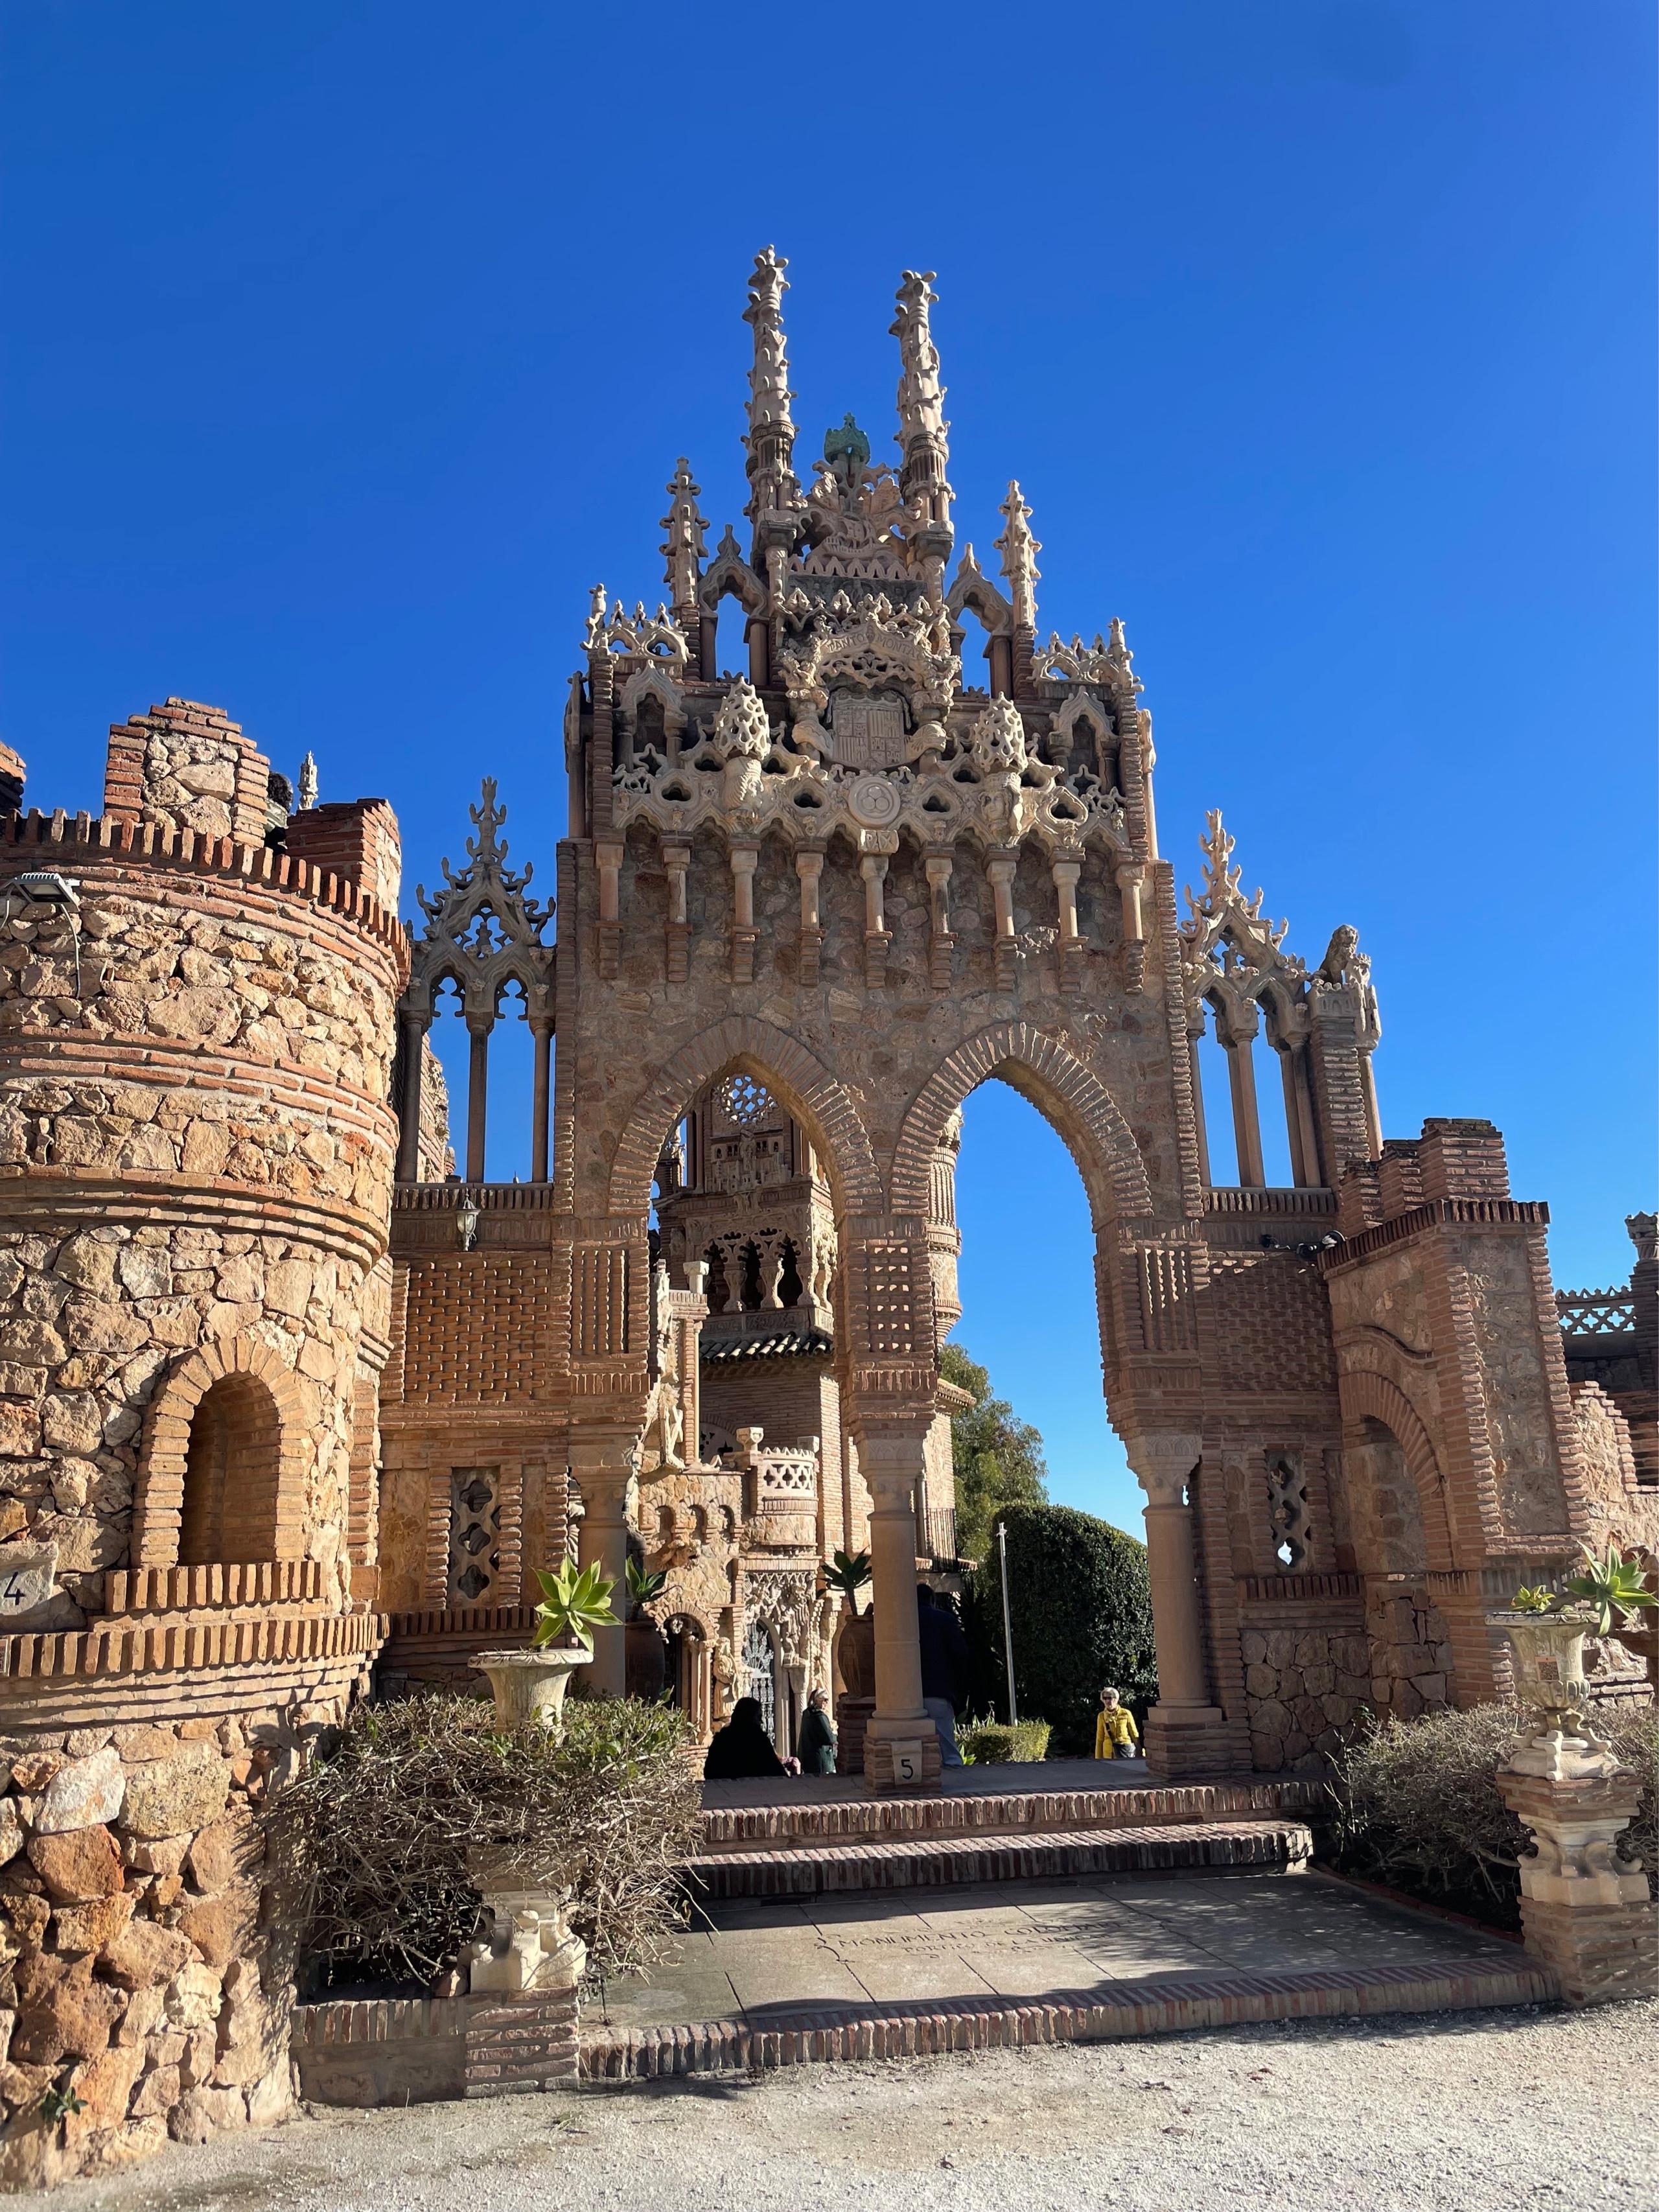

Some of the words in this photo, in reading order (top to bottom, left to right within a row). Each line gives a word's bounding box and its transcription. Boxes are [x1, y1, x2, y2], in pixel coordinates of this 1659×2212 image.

[829, 633, 864, 652] TANTO
[877, 634, 915, 658] MONTA
[3, 1571, 25, 1605] 4
[901, 1759, 914, 1780] 5
[838, 1931, 986, 1947] MONUMENTO
